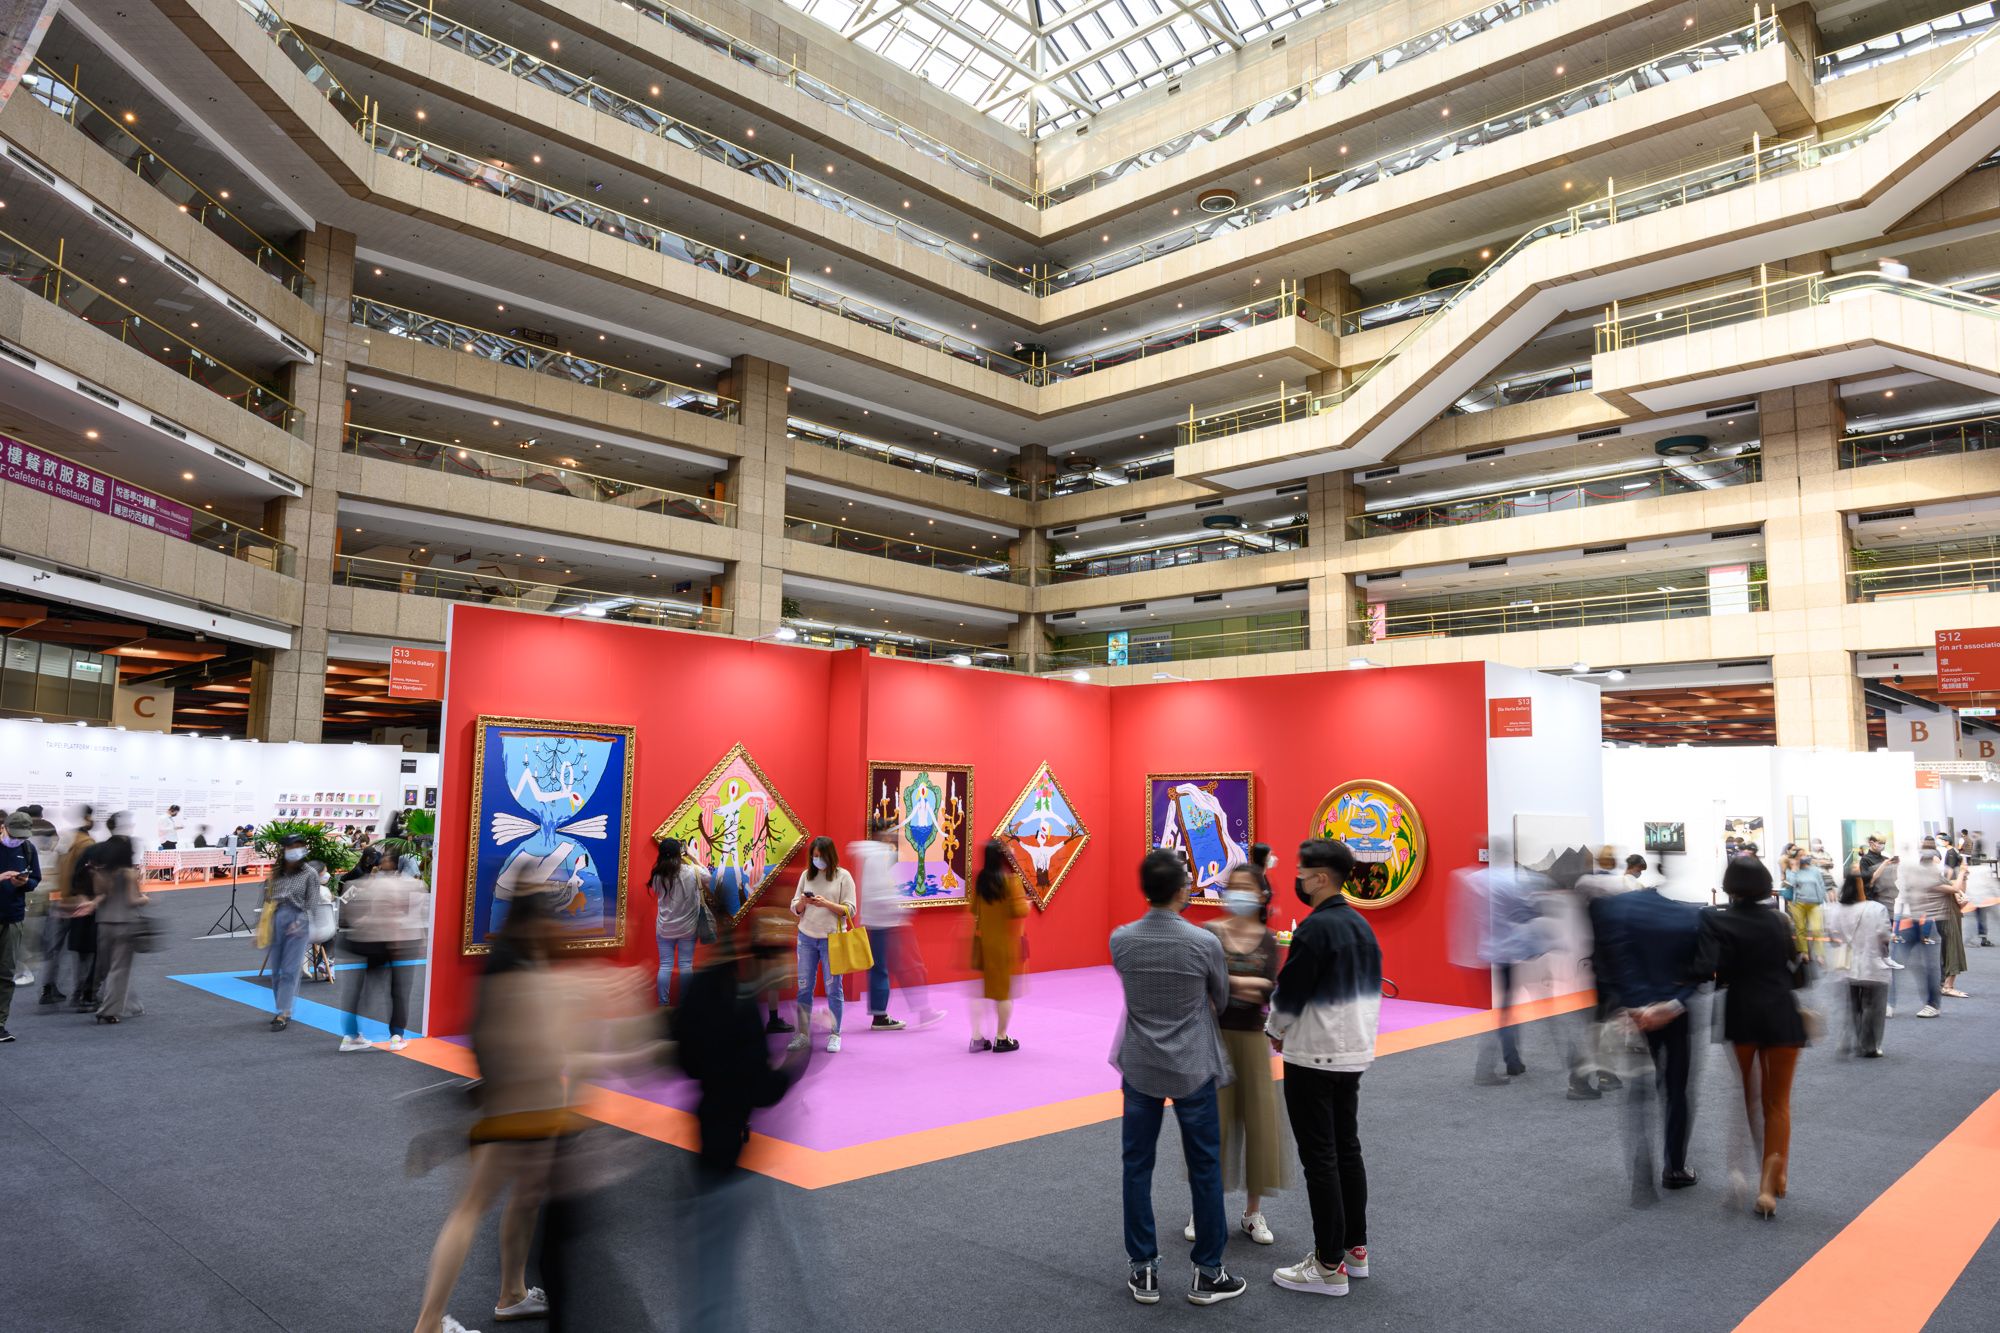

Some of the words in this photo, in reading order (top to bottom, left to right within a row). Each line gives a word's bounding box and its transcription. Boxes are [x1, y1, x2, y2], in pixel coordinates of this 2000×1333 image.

[8, 467, 45, 488] Cafeteria
[47, 480, 54, 491] &
[55, 483, 101, 507] Restaurants
[1938, 632, 1961, 642] S12
[394, 649, 410, 658] S13
[133, 695, 156, 718] C
[1910, 720, 1929, 742] B
[1978, 740, 1996, 758] B
